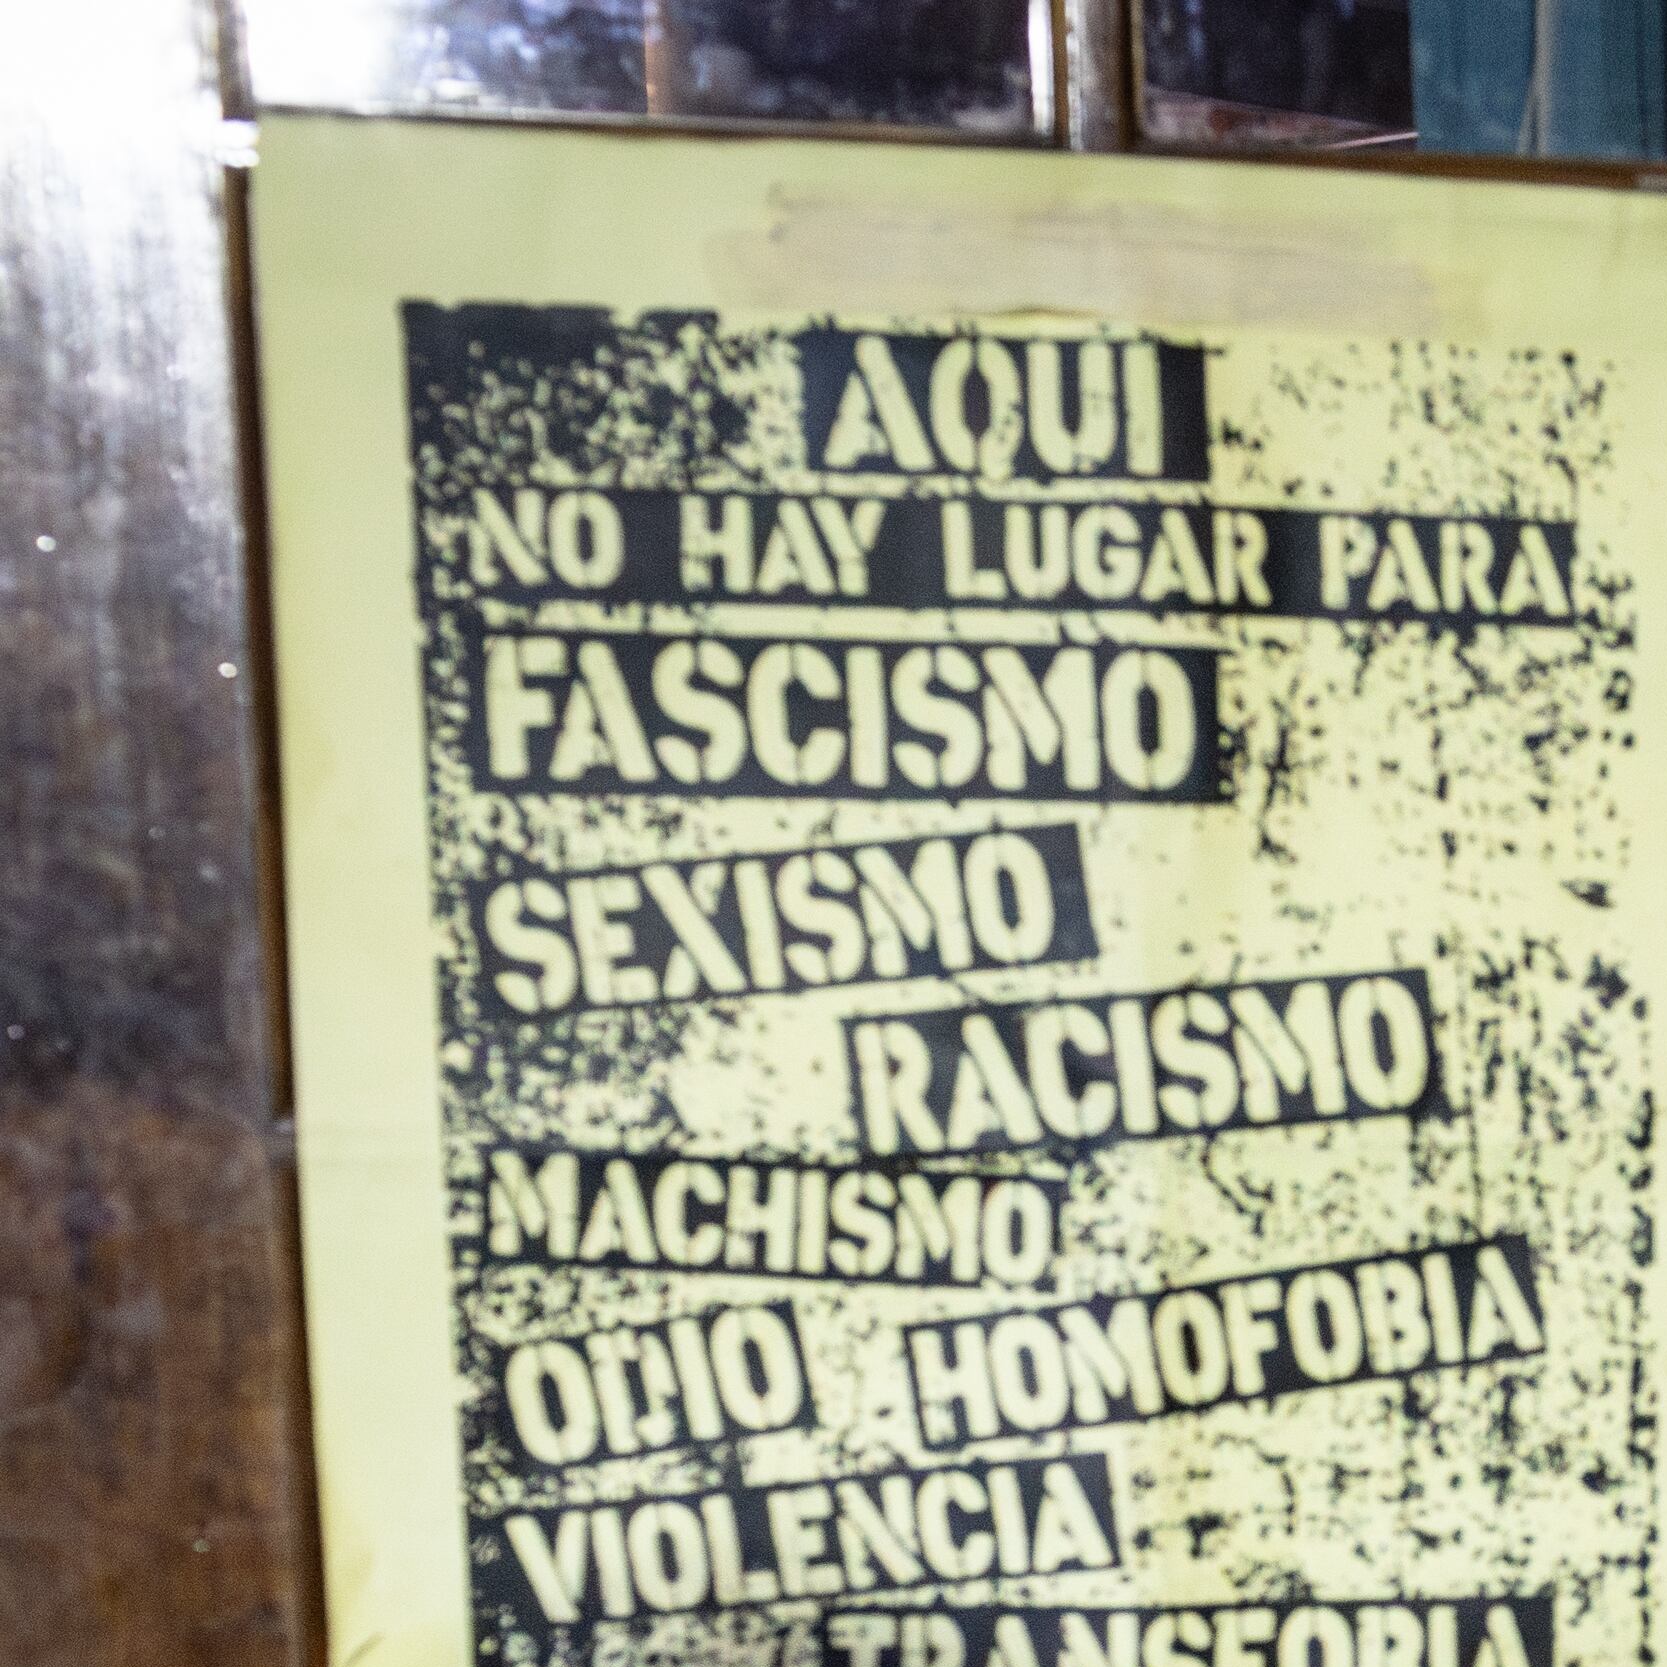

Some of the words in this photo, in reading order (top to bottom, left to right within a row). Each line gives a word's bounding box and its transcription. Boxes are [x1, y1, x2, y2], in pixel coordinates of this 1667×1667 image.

[824, 337, 1160, 478] AQUI
[466, 488, 625, 591] NO
[678, 496, 885, 598] HAY
[944, 502, 1270, 606] LUGAR
[1320, 516, 1573, 618] PARA
[484, 641, 1194, 789] FASCISMO
[483, 833, 1054, 1016] SEXISMO
[853, 974, 1433, 1156] RACISMO
[487, 1161, 1053, 1286] MACHISMO
[505, 1310, 804, 1468] ODIO
[911, 1249, 1544, 1443] HOMOFOBIA
[503, 1461, 1116, 1625] VIOLENCIA
